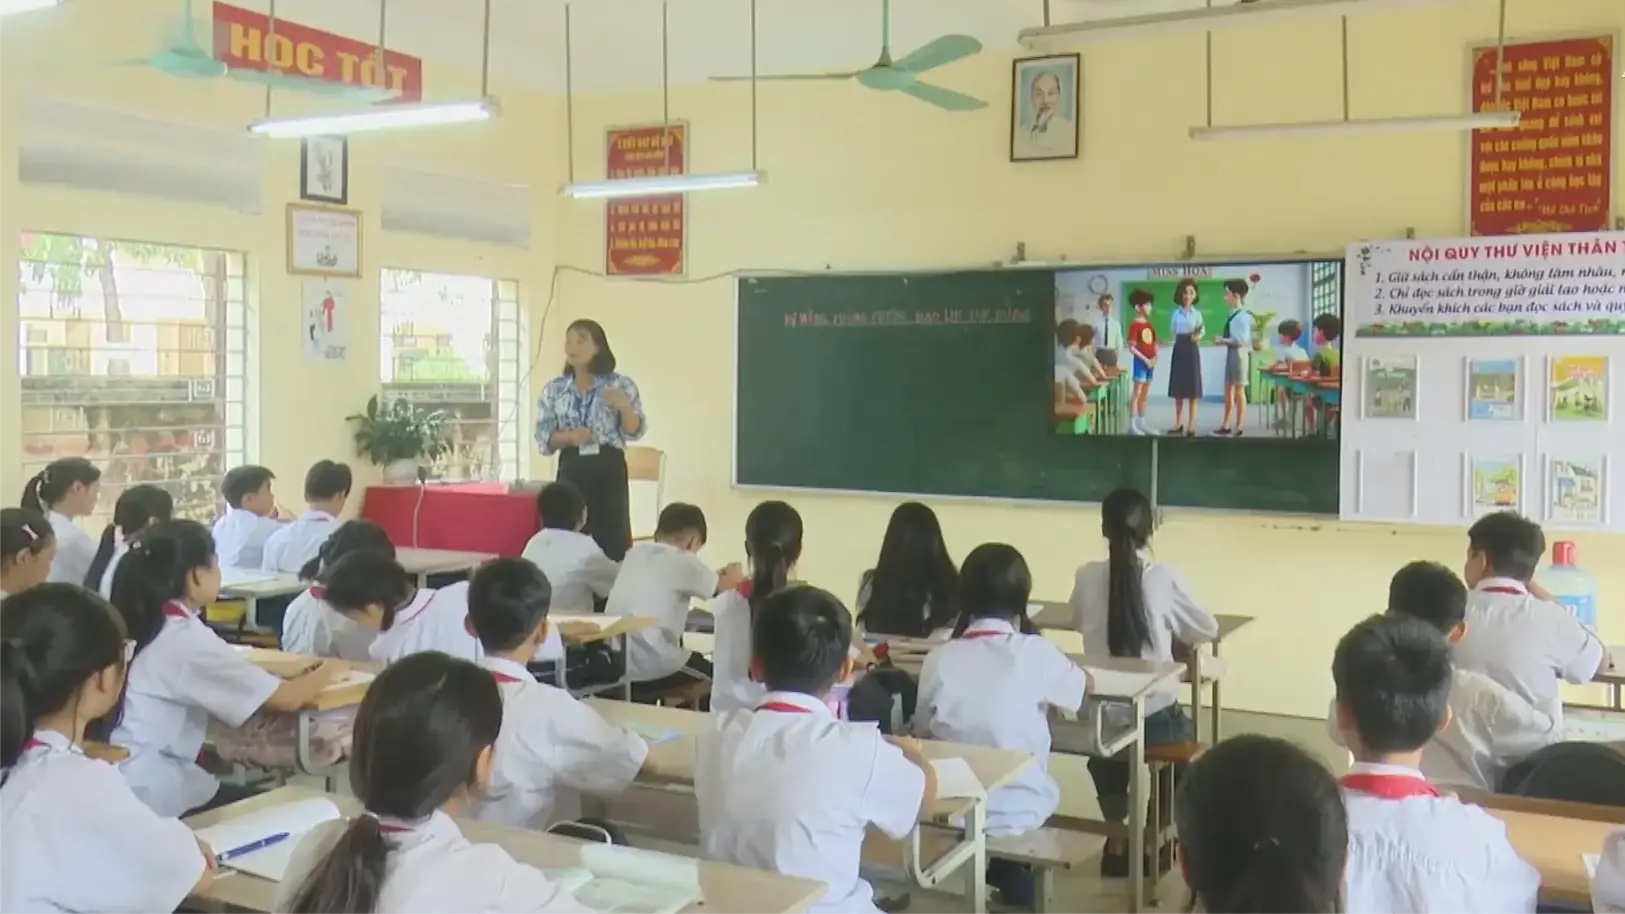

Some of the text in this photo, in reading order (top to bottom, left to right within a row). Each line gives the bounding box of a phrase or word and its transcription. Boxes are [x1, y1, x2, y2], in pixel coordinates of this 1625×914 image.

[230, 22, 324, 76] HỌC
[1409, 244, 1440, 264] NỘI
[1445, 245, 1480, 260] QUY
[1485, 242, 1518, 258] THƯ
[1523, 240, 1563, 260] VIỆN
[1568, 238, 1617, 255] THÂN
[1410, 271, 1439, 282] sách
[1504, 267, 1545, 280] không
[1437, 286, 1464, 298] sách
[1468, 287, 1502, 299] trong
[1437, 302, 1471, 314] khích
[1474, 302, 1495, 313] các
[1553, 300, 1582, 312] sách
